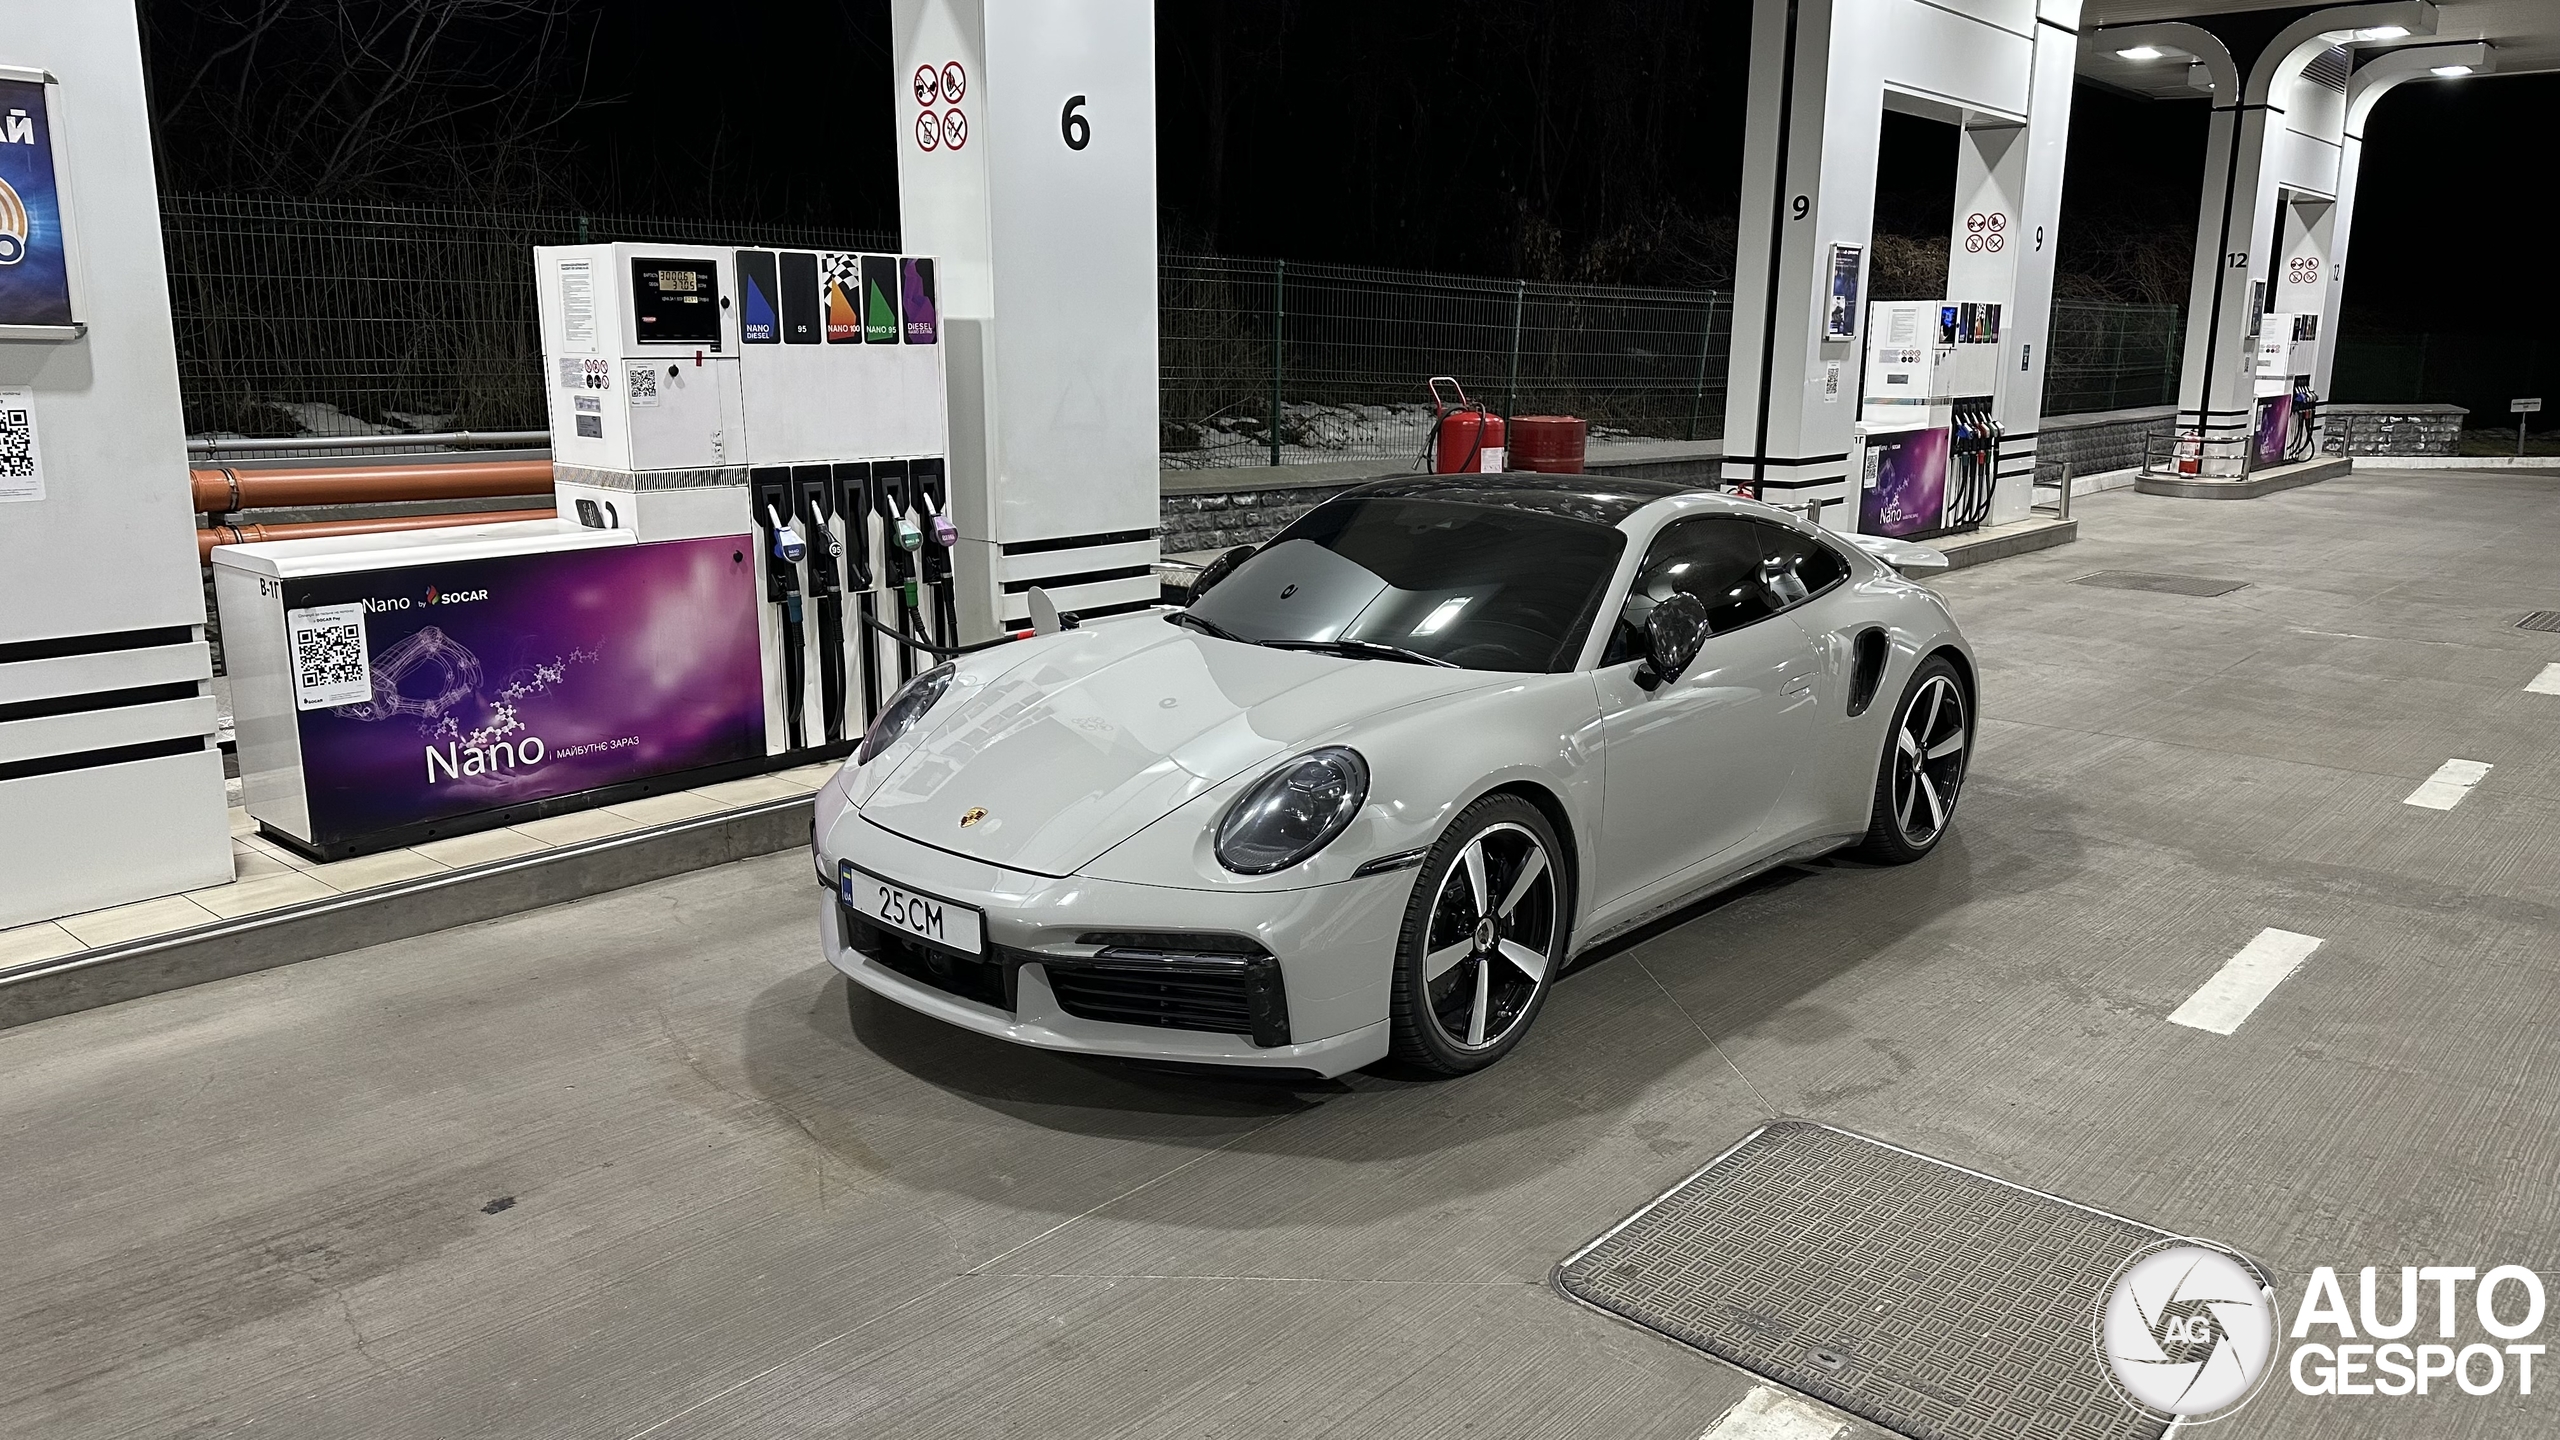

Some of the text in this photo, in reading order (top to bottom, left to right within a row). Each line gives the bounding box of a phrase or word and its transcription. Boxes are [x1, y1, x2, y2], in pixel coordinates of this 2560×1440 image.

[1061, 95, 1090, 150] 6
[1793, 195, 1810, 221] 9
[2036, 226, 2044, 252] 9
[2227, 253, 2248, 268] 12
[797, 325, 807, 333] 95
[828, 325, 861, 333] NANO 100
[866, 326, 897, 334] NANO 95
[1880, 507, 1902, 524] Nano
[362, 589, 488, 614] Nano by SOCAR
[425, 736, 545, 784] Nano
[556, 735, 640, 760] МАЙБУТНЄ ЗАРАЗ
